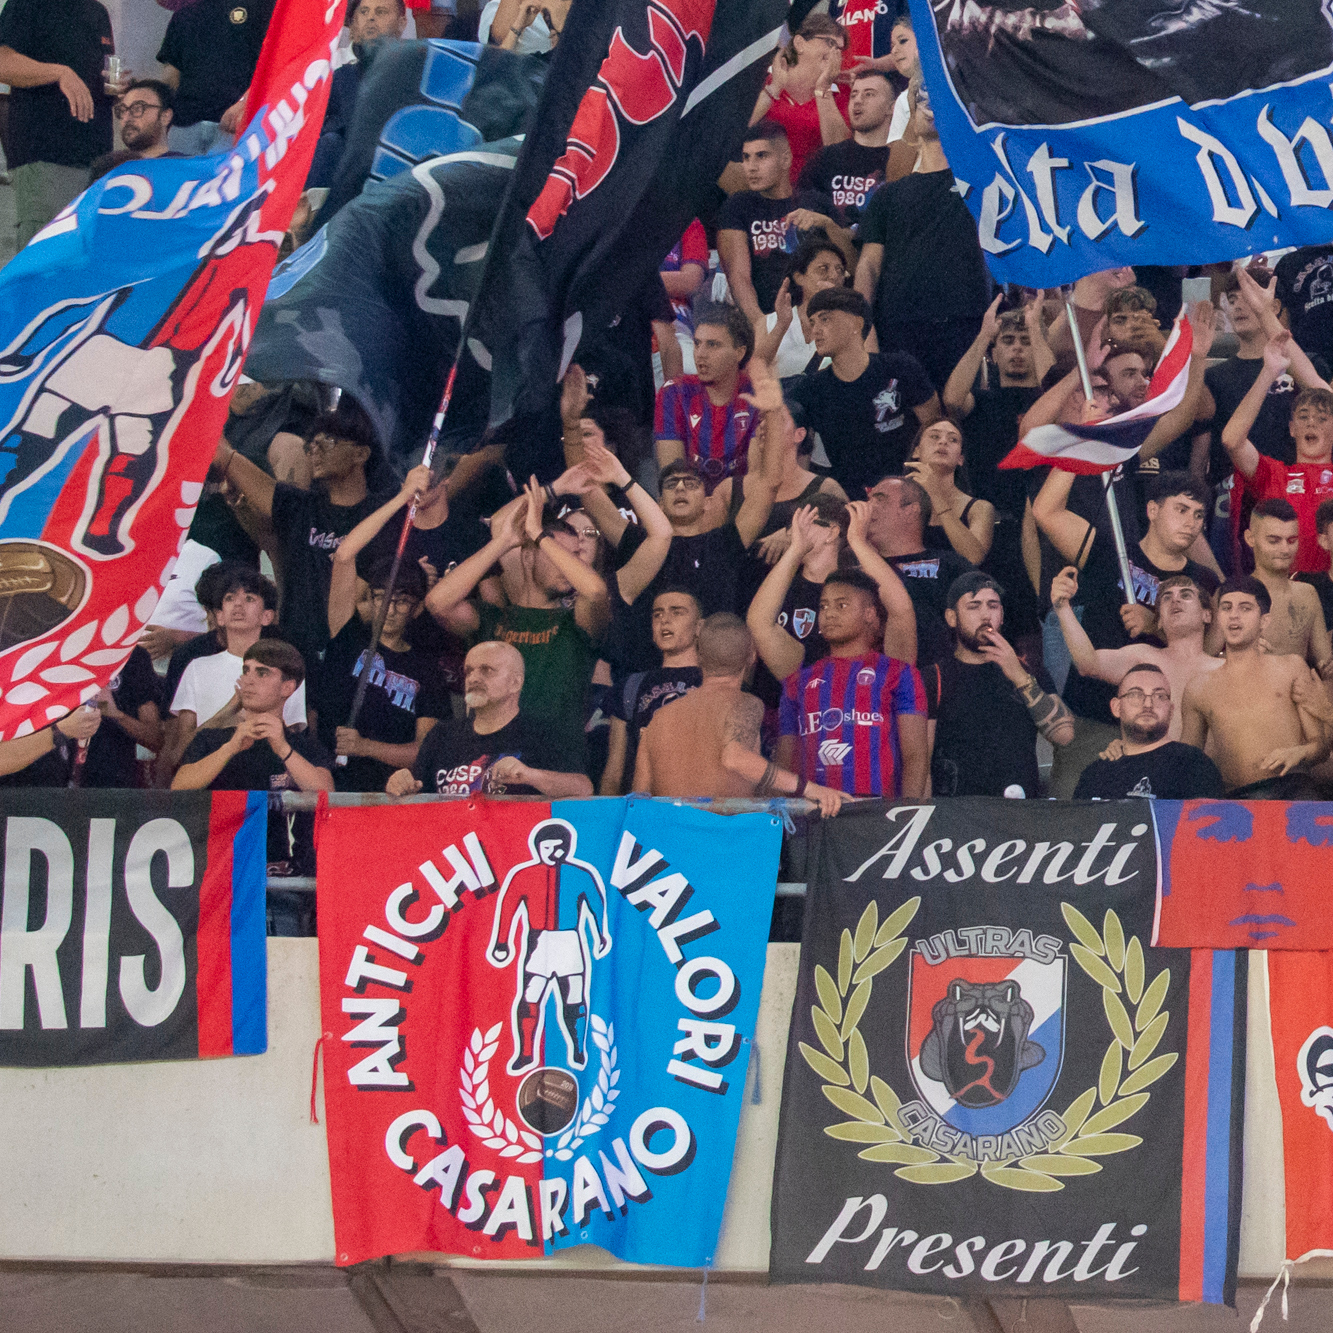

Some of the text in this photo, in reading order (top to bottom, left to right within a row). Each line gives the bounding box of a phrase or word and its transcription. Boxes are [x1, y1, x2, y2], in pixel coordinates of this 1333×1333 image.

[831, 174, 876, 192] CUSP
[832, 190, 866, 208] 1980
[751, 233, 787, 251] 1980
[843, 709, 884, 727] shoes
[436, 764, 483, 785] CUSP
[842, 803, 1149, 887] Assenti
[341, 829, 736, 1091] ANTICHI VALORI
[916, 924, 1065, 966] ULTRAS
[895, 1097, 1068, 1163] CASARANO
[384, 1105, 692, 1242] CASARANO
[804, 1192, 1149, 1285] Presenti
